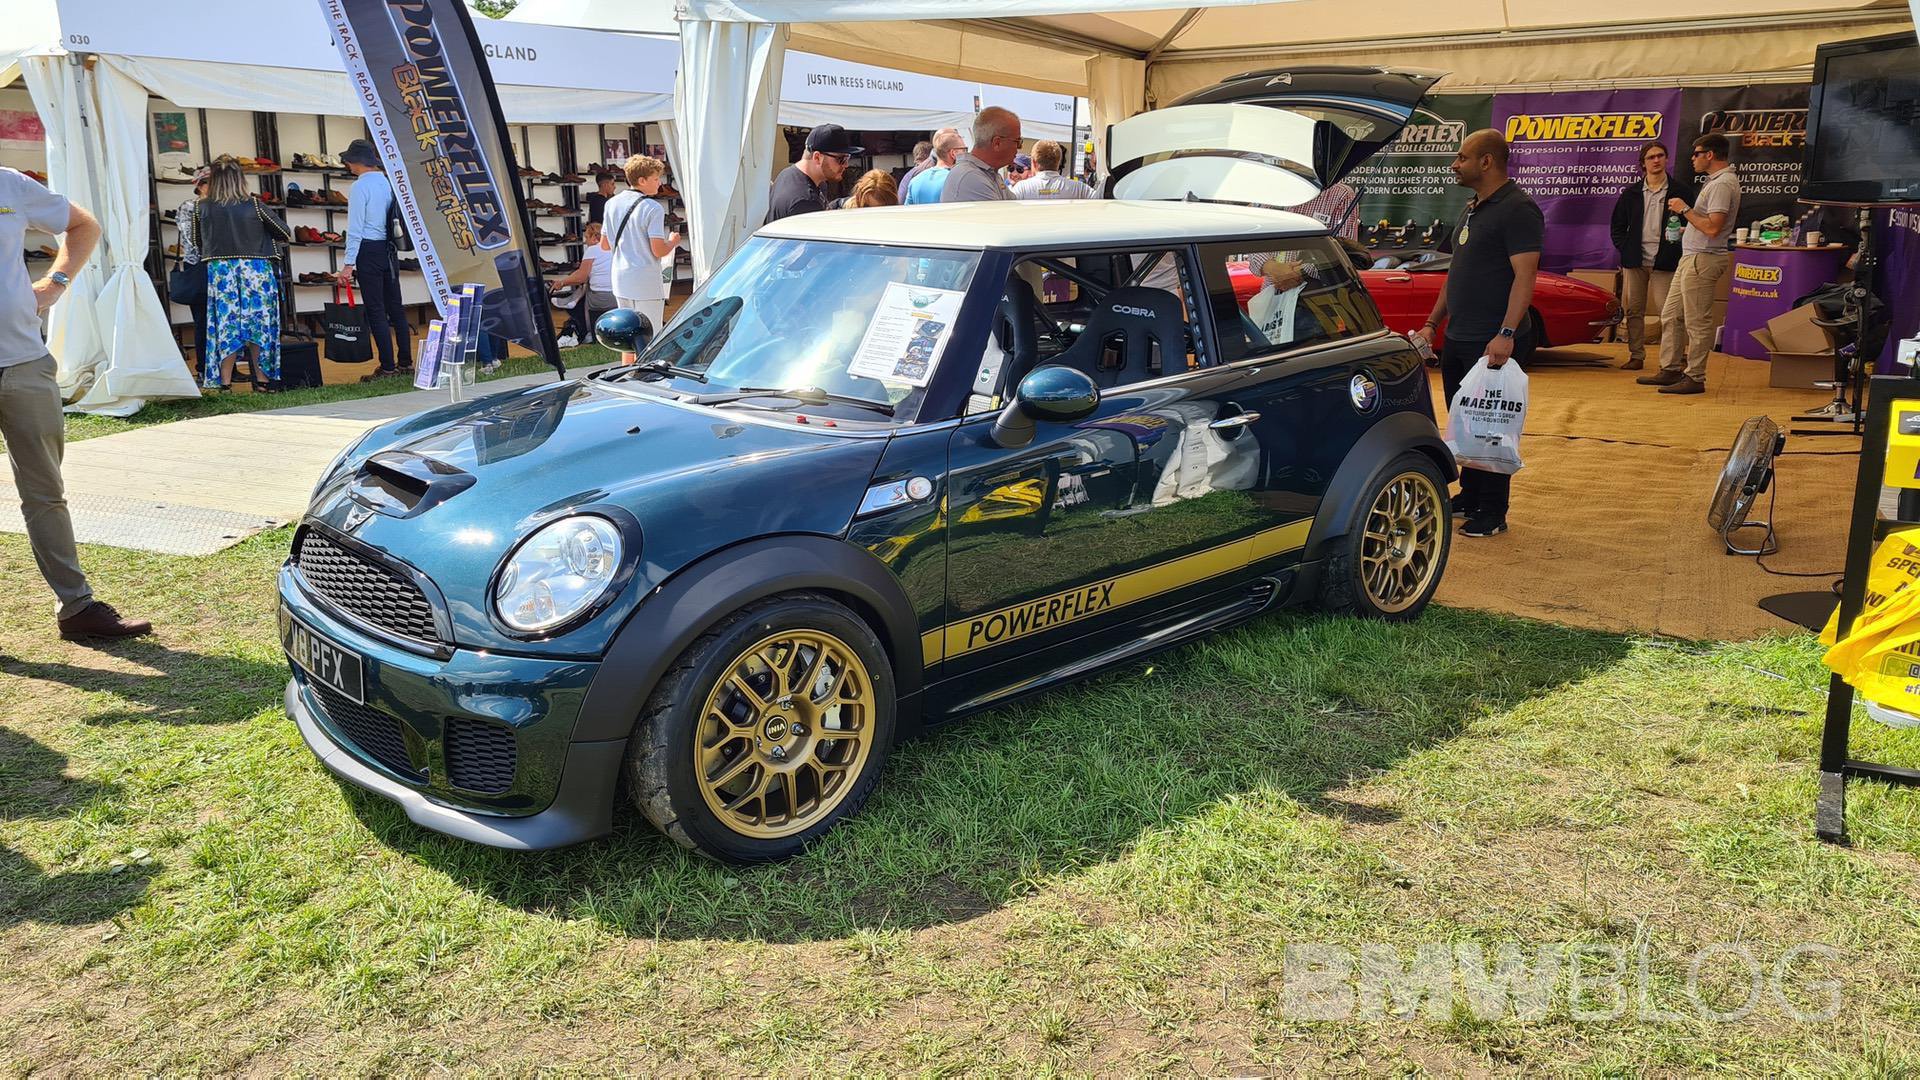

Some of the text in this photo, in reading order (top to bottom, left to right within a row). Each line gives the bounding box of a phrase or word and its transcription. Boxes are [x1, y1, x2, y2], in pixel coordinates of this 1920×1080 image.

[69, 34, 90, 45] 030
[485, 44, 537, 61] GLAND
[807, 73, 904, 92] JUSTIN REESS ENGLAND
[391, 62, 440, 151] Black
[1054, 102, 1072, 112] STORM
[385, 0, 512, 242] POWERFLEX
[1505, 114, 1662, 143] POWERFLEX
[1743, 131, 1792, 147] Black
[1395, 143, 1453, 152] COLLECTION
[1590, 145, 1642, 153] suspensi
[336, 22, 359, 61] TRACK
[355, 71, 378, 109] READY
[371, 110, 384, 127] TO
[378, 130, 397, 160] RACE
[394, 169, 423, 236] ENGINEERED
[419, 237, 429, 252] TO
[425, 255, 437, 267] BE
[431, 269, 444, 286] THE
[438, 288, 449, 310] BES
[1351, 166, 1380, 174] ODERN
[1382, 166, 1400, 174] DAY
[1401, 166, 1425, 174] ROAD
[1519, 165, 1638, 174] IMPROVED PERFORMANCE,
[1341, 176, 1386, 184] USPENSION
[1388, 176, 1421, 184] BUSHES
[1422, 176, 1440, 184] FOR
[1545, 176, 1590, 185] STABILITY
[1591, 175, 1599, 184] &
[1737, 174, 1787, 183] ULTIMATE
[1392, 186, 1426, 195] CLASSIC
[1427, 186, 1445, 195] CAR
[1535, 187, 1560, 195] YOUR
[1562, 187, 1589, 195] DAILY
[1590, 187, 1617, 195] ROAD
[1740, 185, 1781, 194] CHASSIS
[1737, 265, 1780, 281] POWERFLEX
[1112, 304, 1156, 318] COBRA
[1485, 390, 1502, 398] THE
[1460, 397, 1523, 413] MAESTROS
[968, 582, 1115, 649] POWERFLEX
[311, 635, 345, 689] PFX
